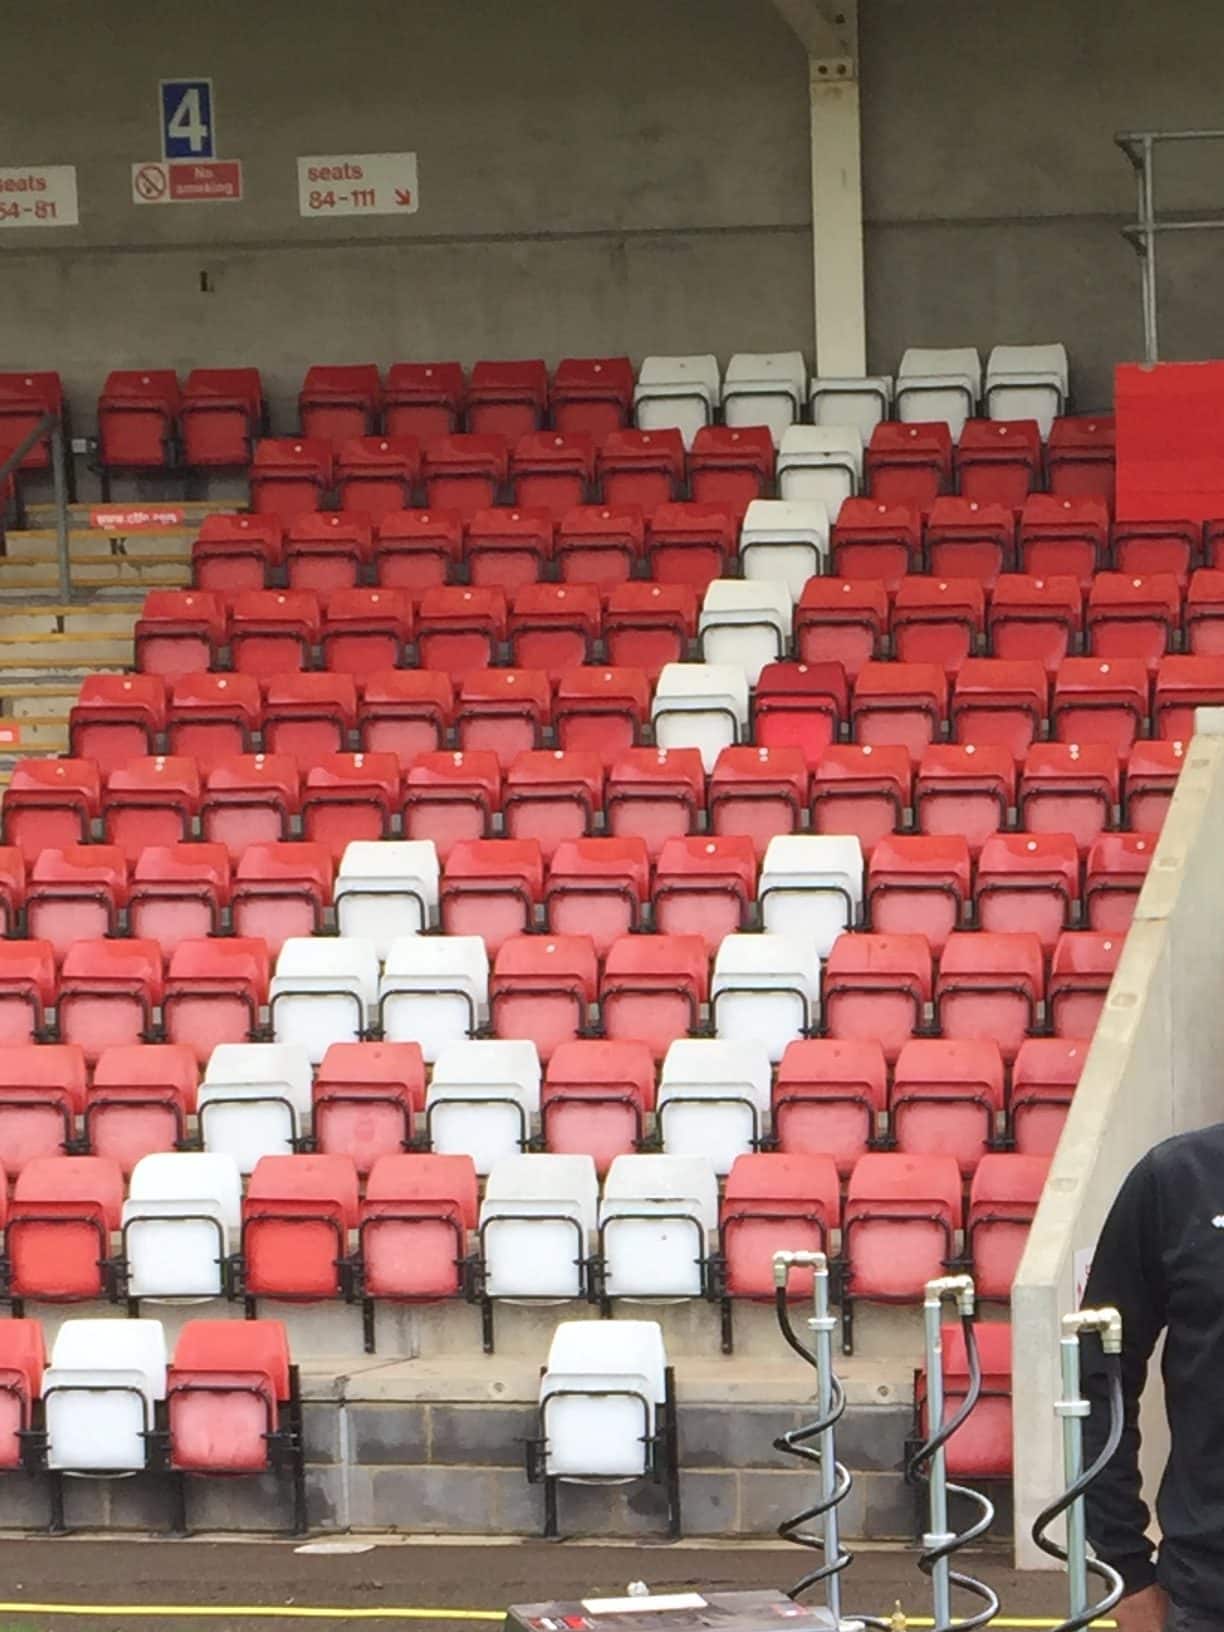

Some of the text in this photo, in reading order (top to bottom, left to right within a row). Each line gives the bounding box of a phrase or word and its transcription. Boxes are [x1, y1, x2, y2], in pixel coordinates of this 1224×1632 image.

[168, 88, 208, 152] 4
[194, 167, 213, 178] No
[307, 163, 363, 181] seats
[109, 537, 127, 555] K
